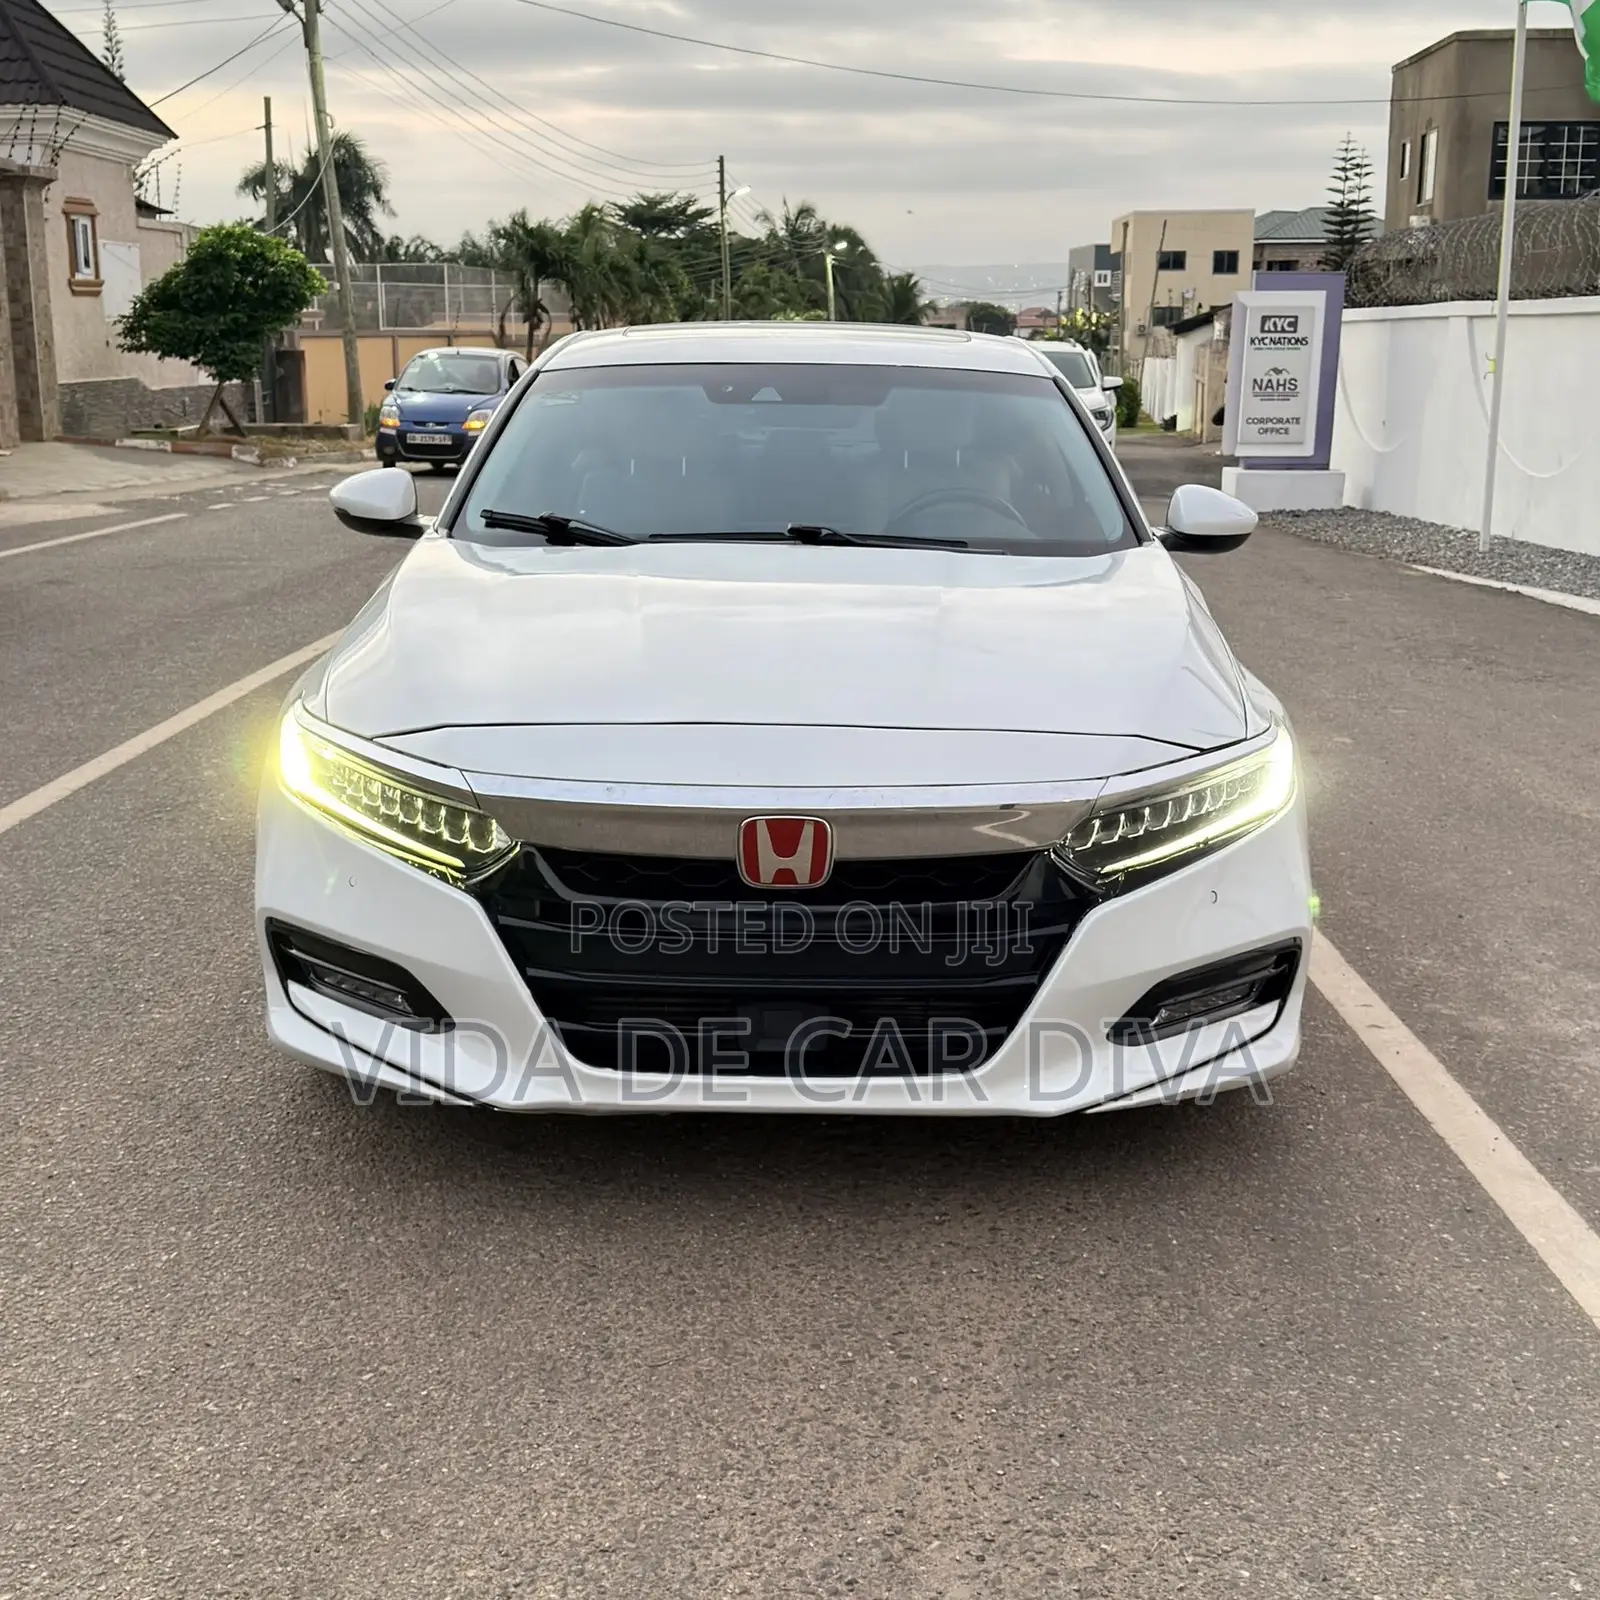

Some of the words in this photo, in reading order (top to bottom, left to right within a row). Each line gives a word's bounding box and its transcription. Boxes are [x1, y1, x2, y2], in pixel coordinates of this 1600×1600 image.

[1263, 317, 1296, 332] KYC
[1252, 377, 1299, 392] NAHS
[1245, 416, 1301, 426] CORPORATE
[1257, 427, 1290, 436] OFFICE
